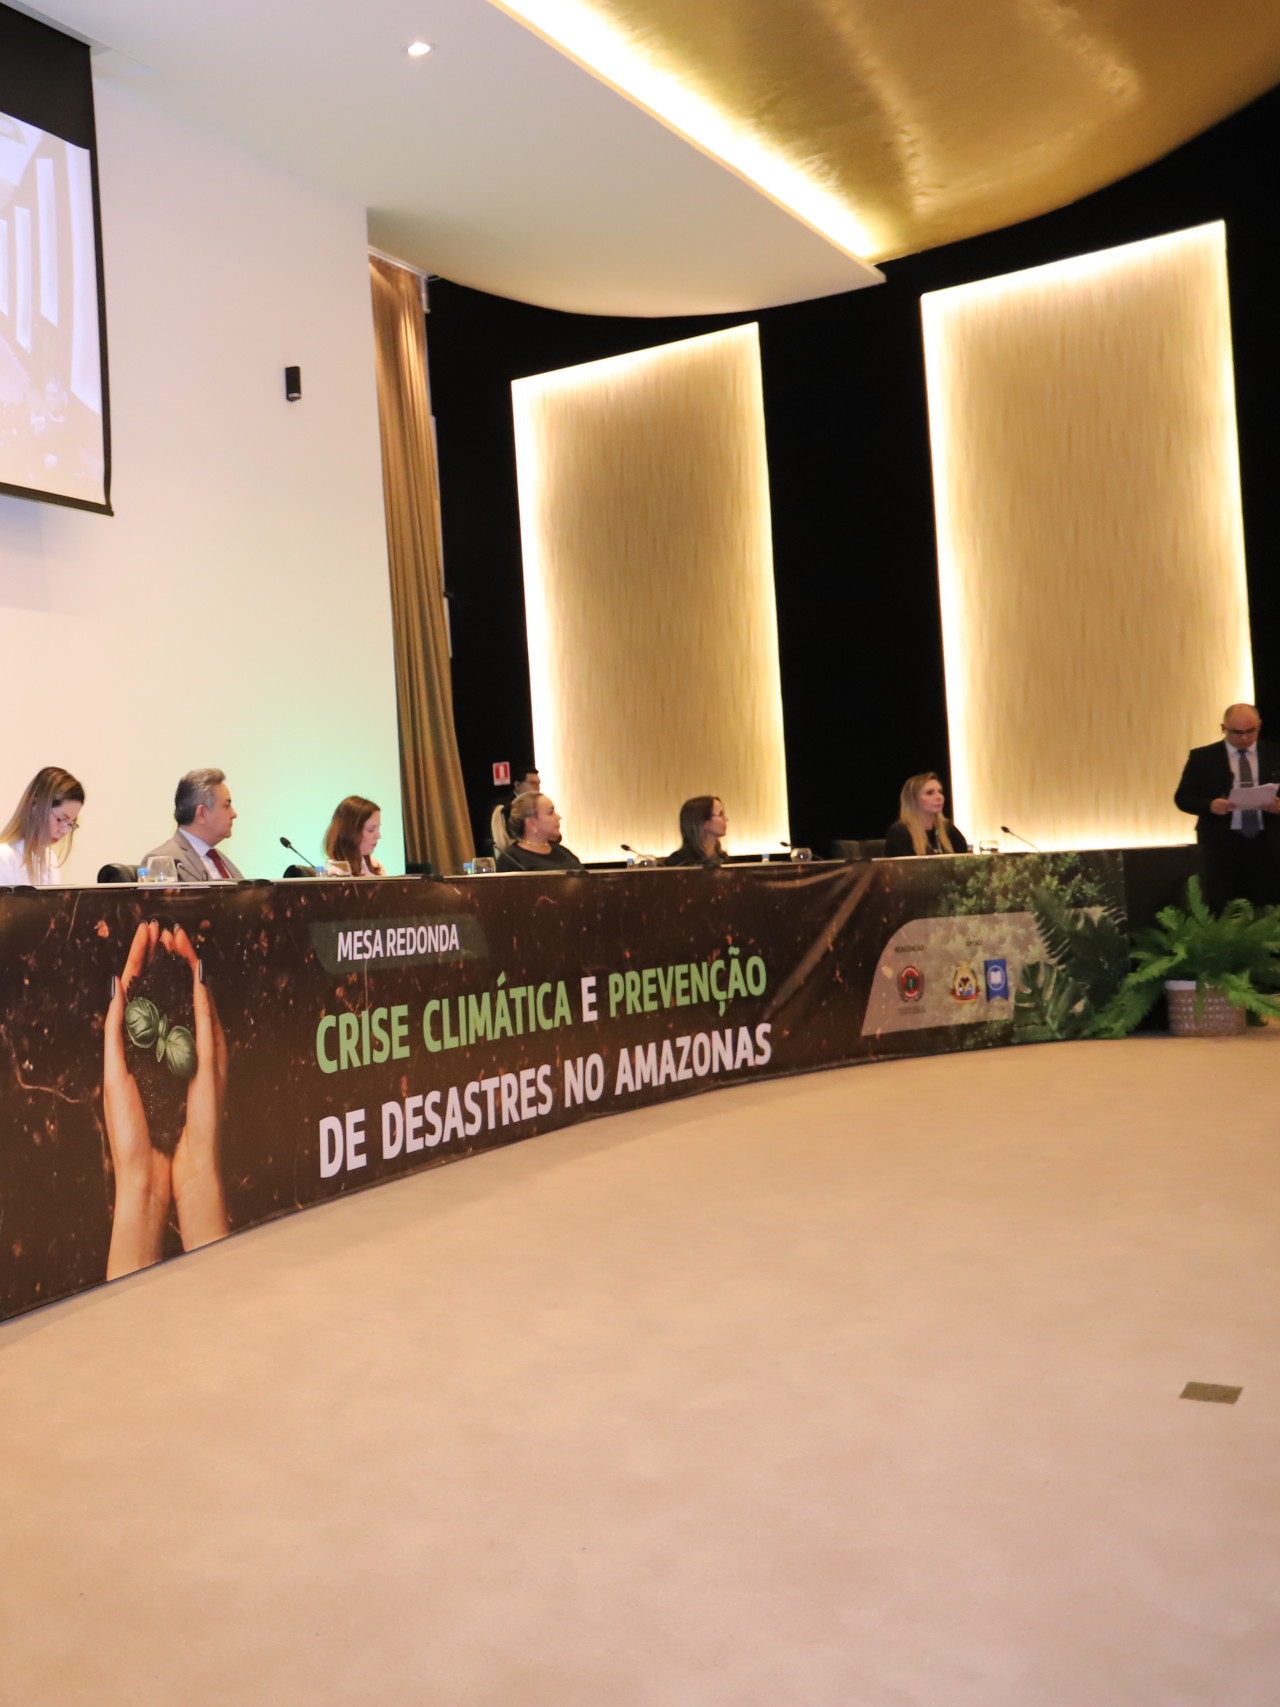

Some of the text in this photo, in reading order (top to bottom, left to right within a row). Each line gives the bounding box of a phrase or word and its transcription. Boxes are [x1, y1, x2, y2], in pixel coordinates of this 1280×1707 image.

[337, 923, 460, 962] MESA REDONDA
[315, 946, 767, 1074] CRISE CLIMÁTICA E PREVENÇÃO
[319, 1022, 773, 1178] DE DESASTRES NO AMAZONAS
